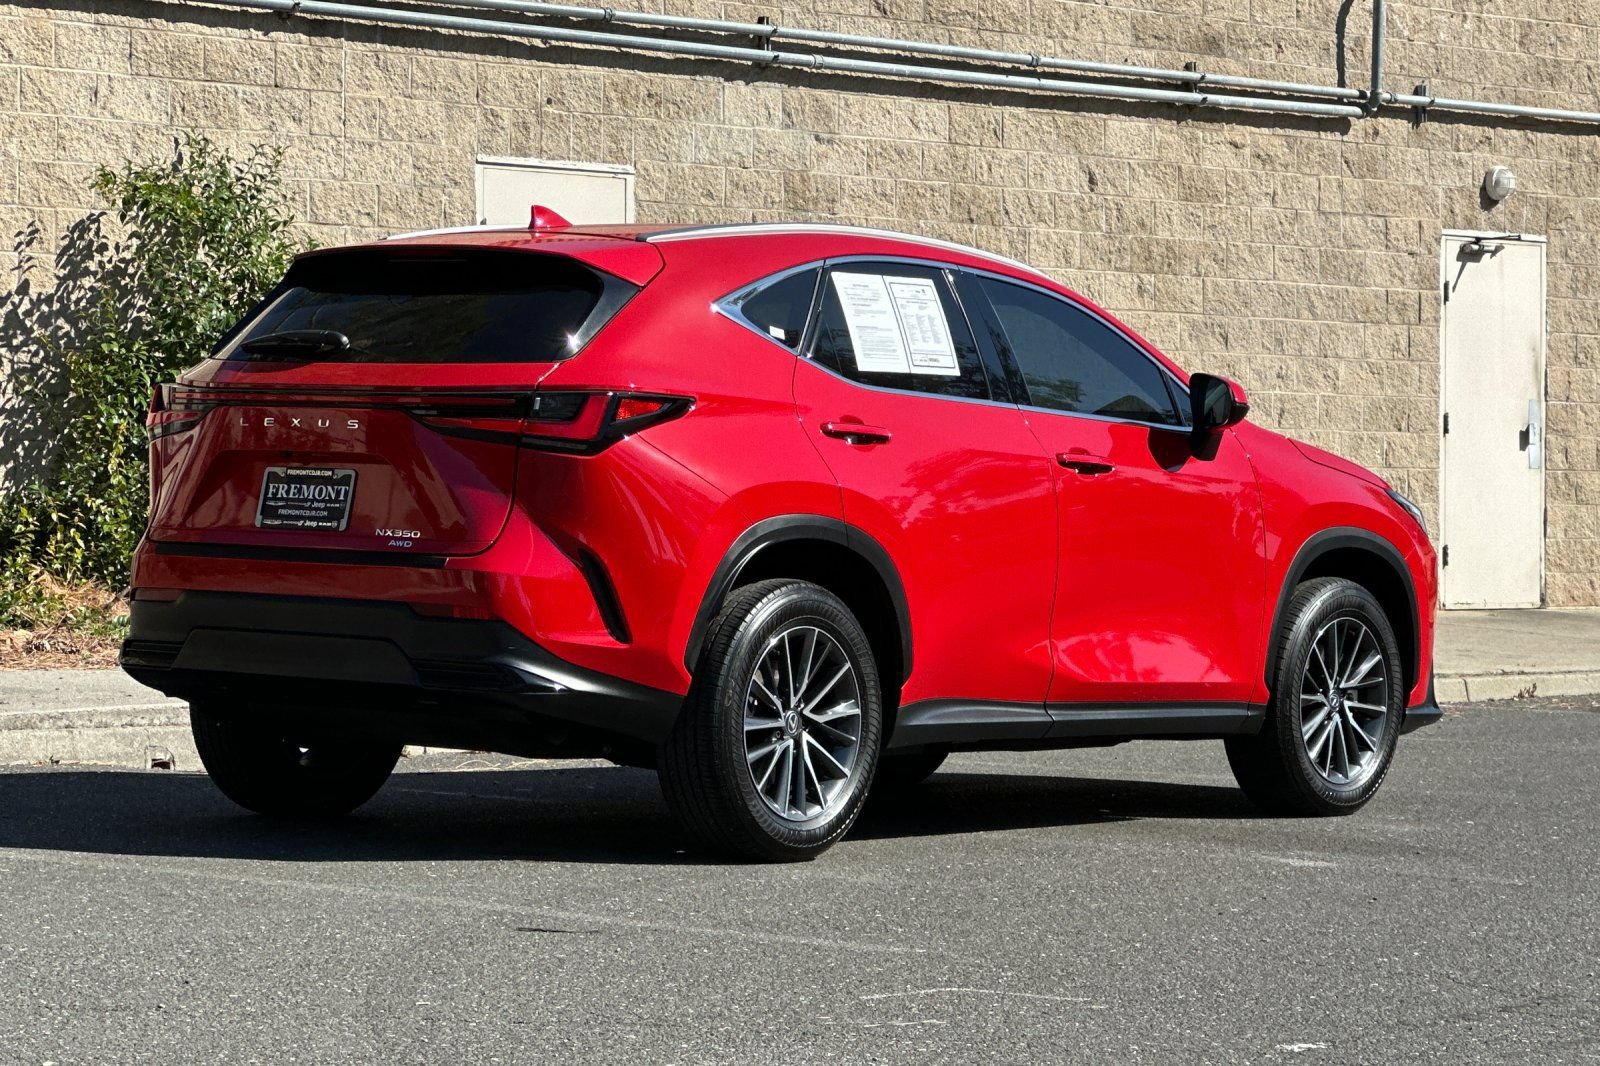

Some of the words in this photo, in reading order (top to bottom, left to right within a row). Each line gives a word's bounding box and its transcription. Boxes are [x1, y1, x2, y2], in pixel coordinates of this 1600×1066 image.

[239, 417, 359, 429] LEXUS
[267, 483, 349, 500] FREMONT
[278, 508, 328, 516] FREMONTCDJR.COM
[388, 539, 413, 548] AWD
